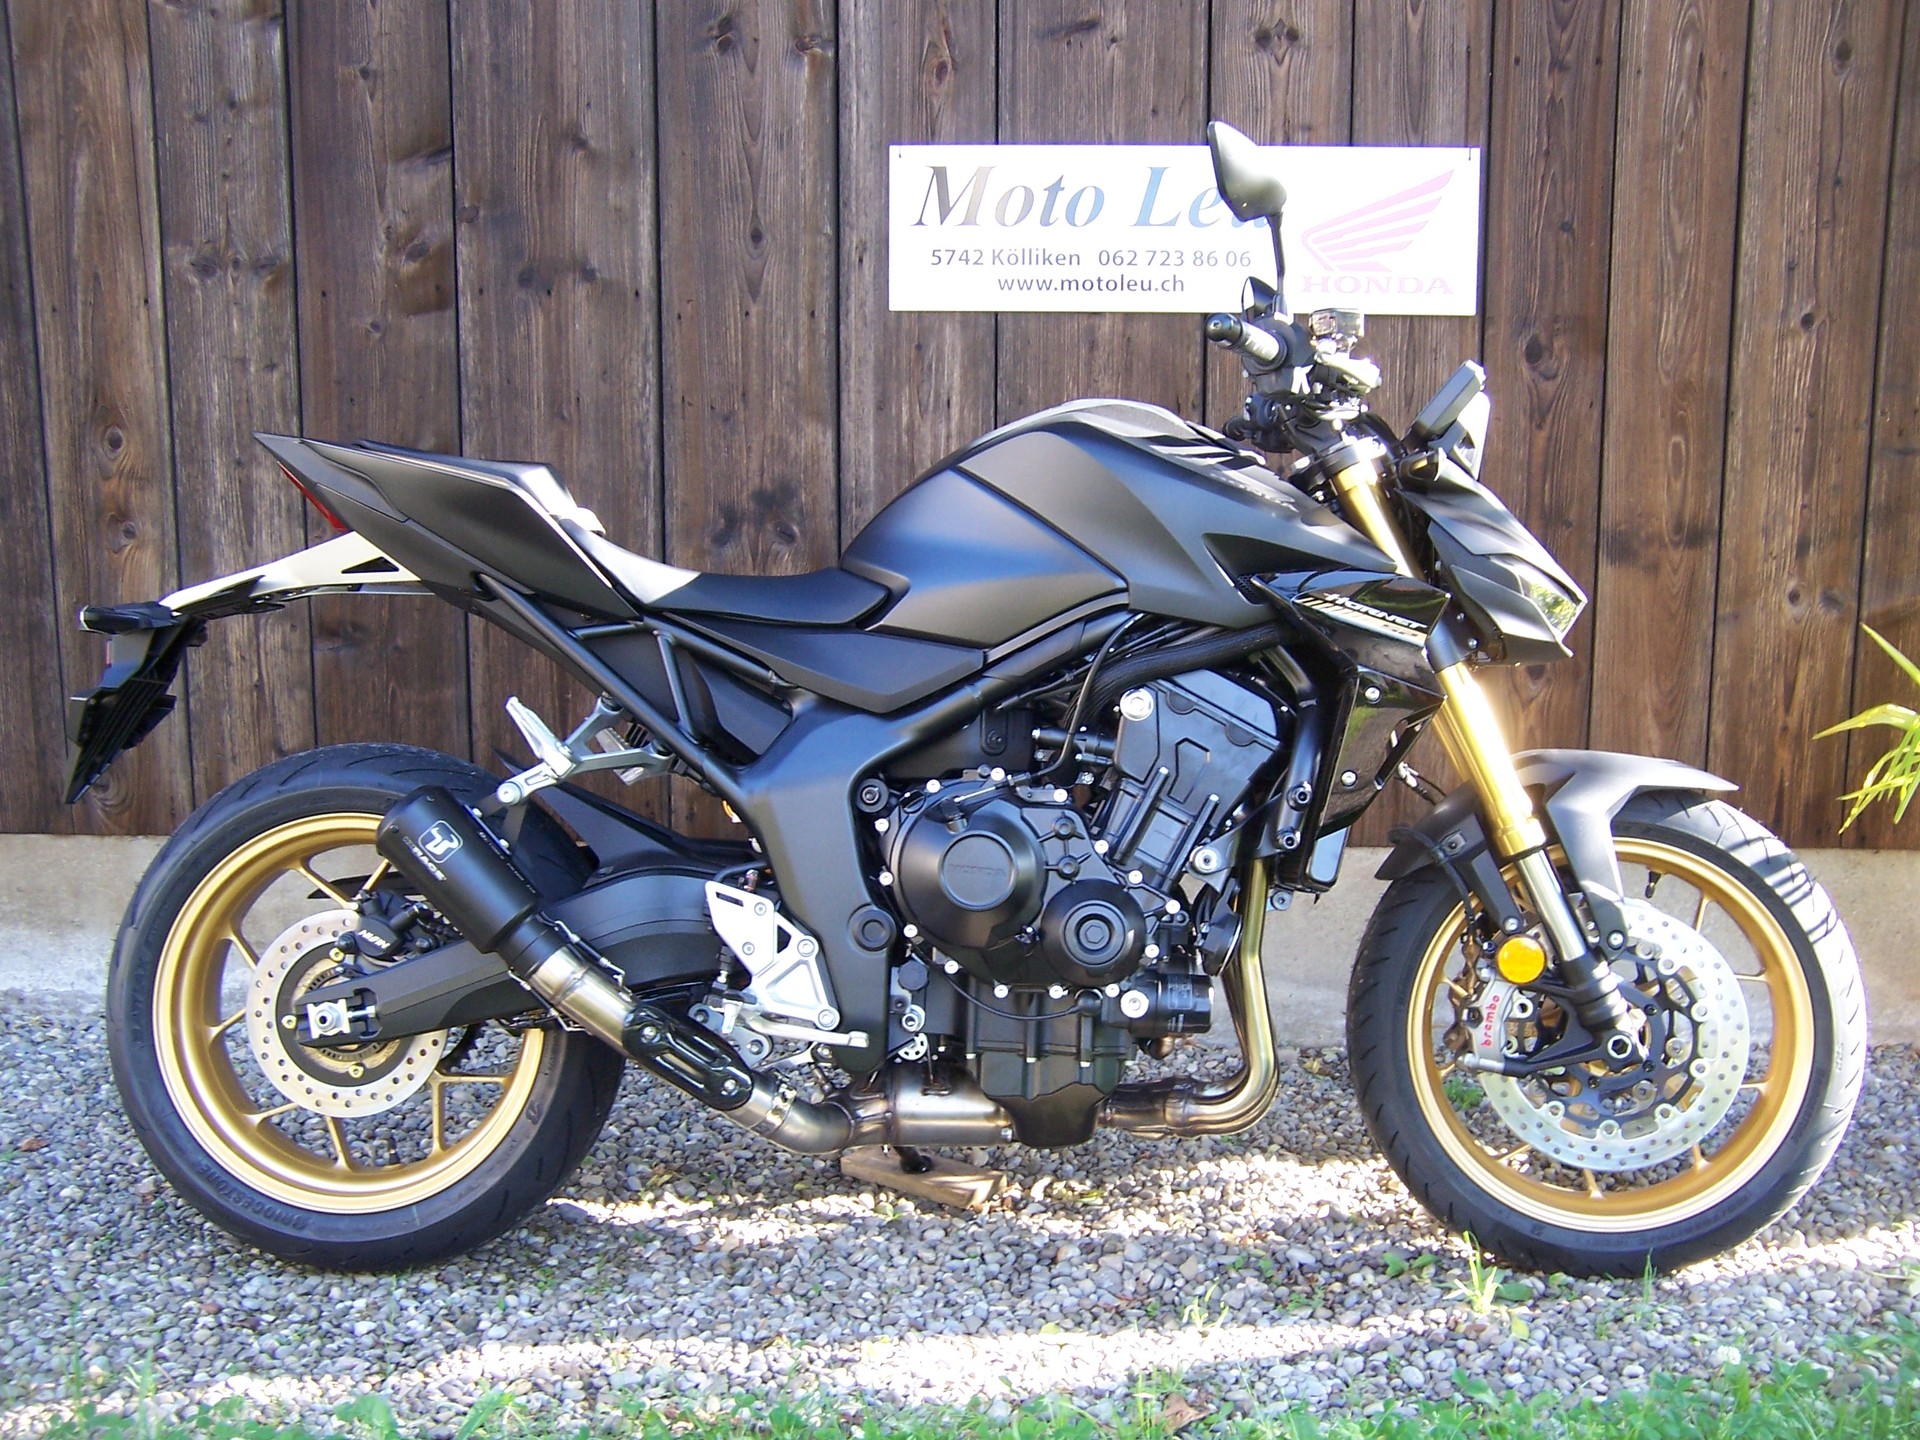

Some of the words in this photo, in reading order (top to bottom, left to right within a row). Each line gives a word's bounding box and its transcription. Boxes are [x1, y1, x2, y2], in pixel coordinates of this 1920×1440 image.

[909, 165, 1105, 228] Moto
[1129, 166, 1270, 229] Le
[930, 248, 984, 266] 5742
[991, 247, 1081, 266] Kölliken
[1097, 249, 1138, 267] 062
[1145, 250, 1185, 267] 723
[1192, 250, 1219, 267] 86
[1225, 250, 1251, 267] 06
[997, 273, 1185, 292] www.motoleu.ch
[1300, 275, 1454, 294] HONDA
[1323, 592, 1428, 629] HORNET
[1480, 994, 1501, 1049] brembo
